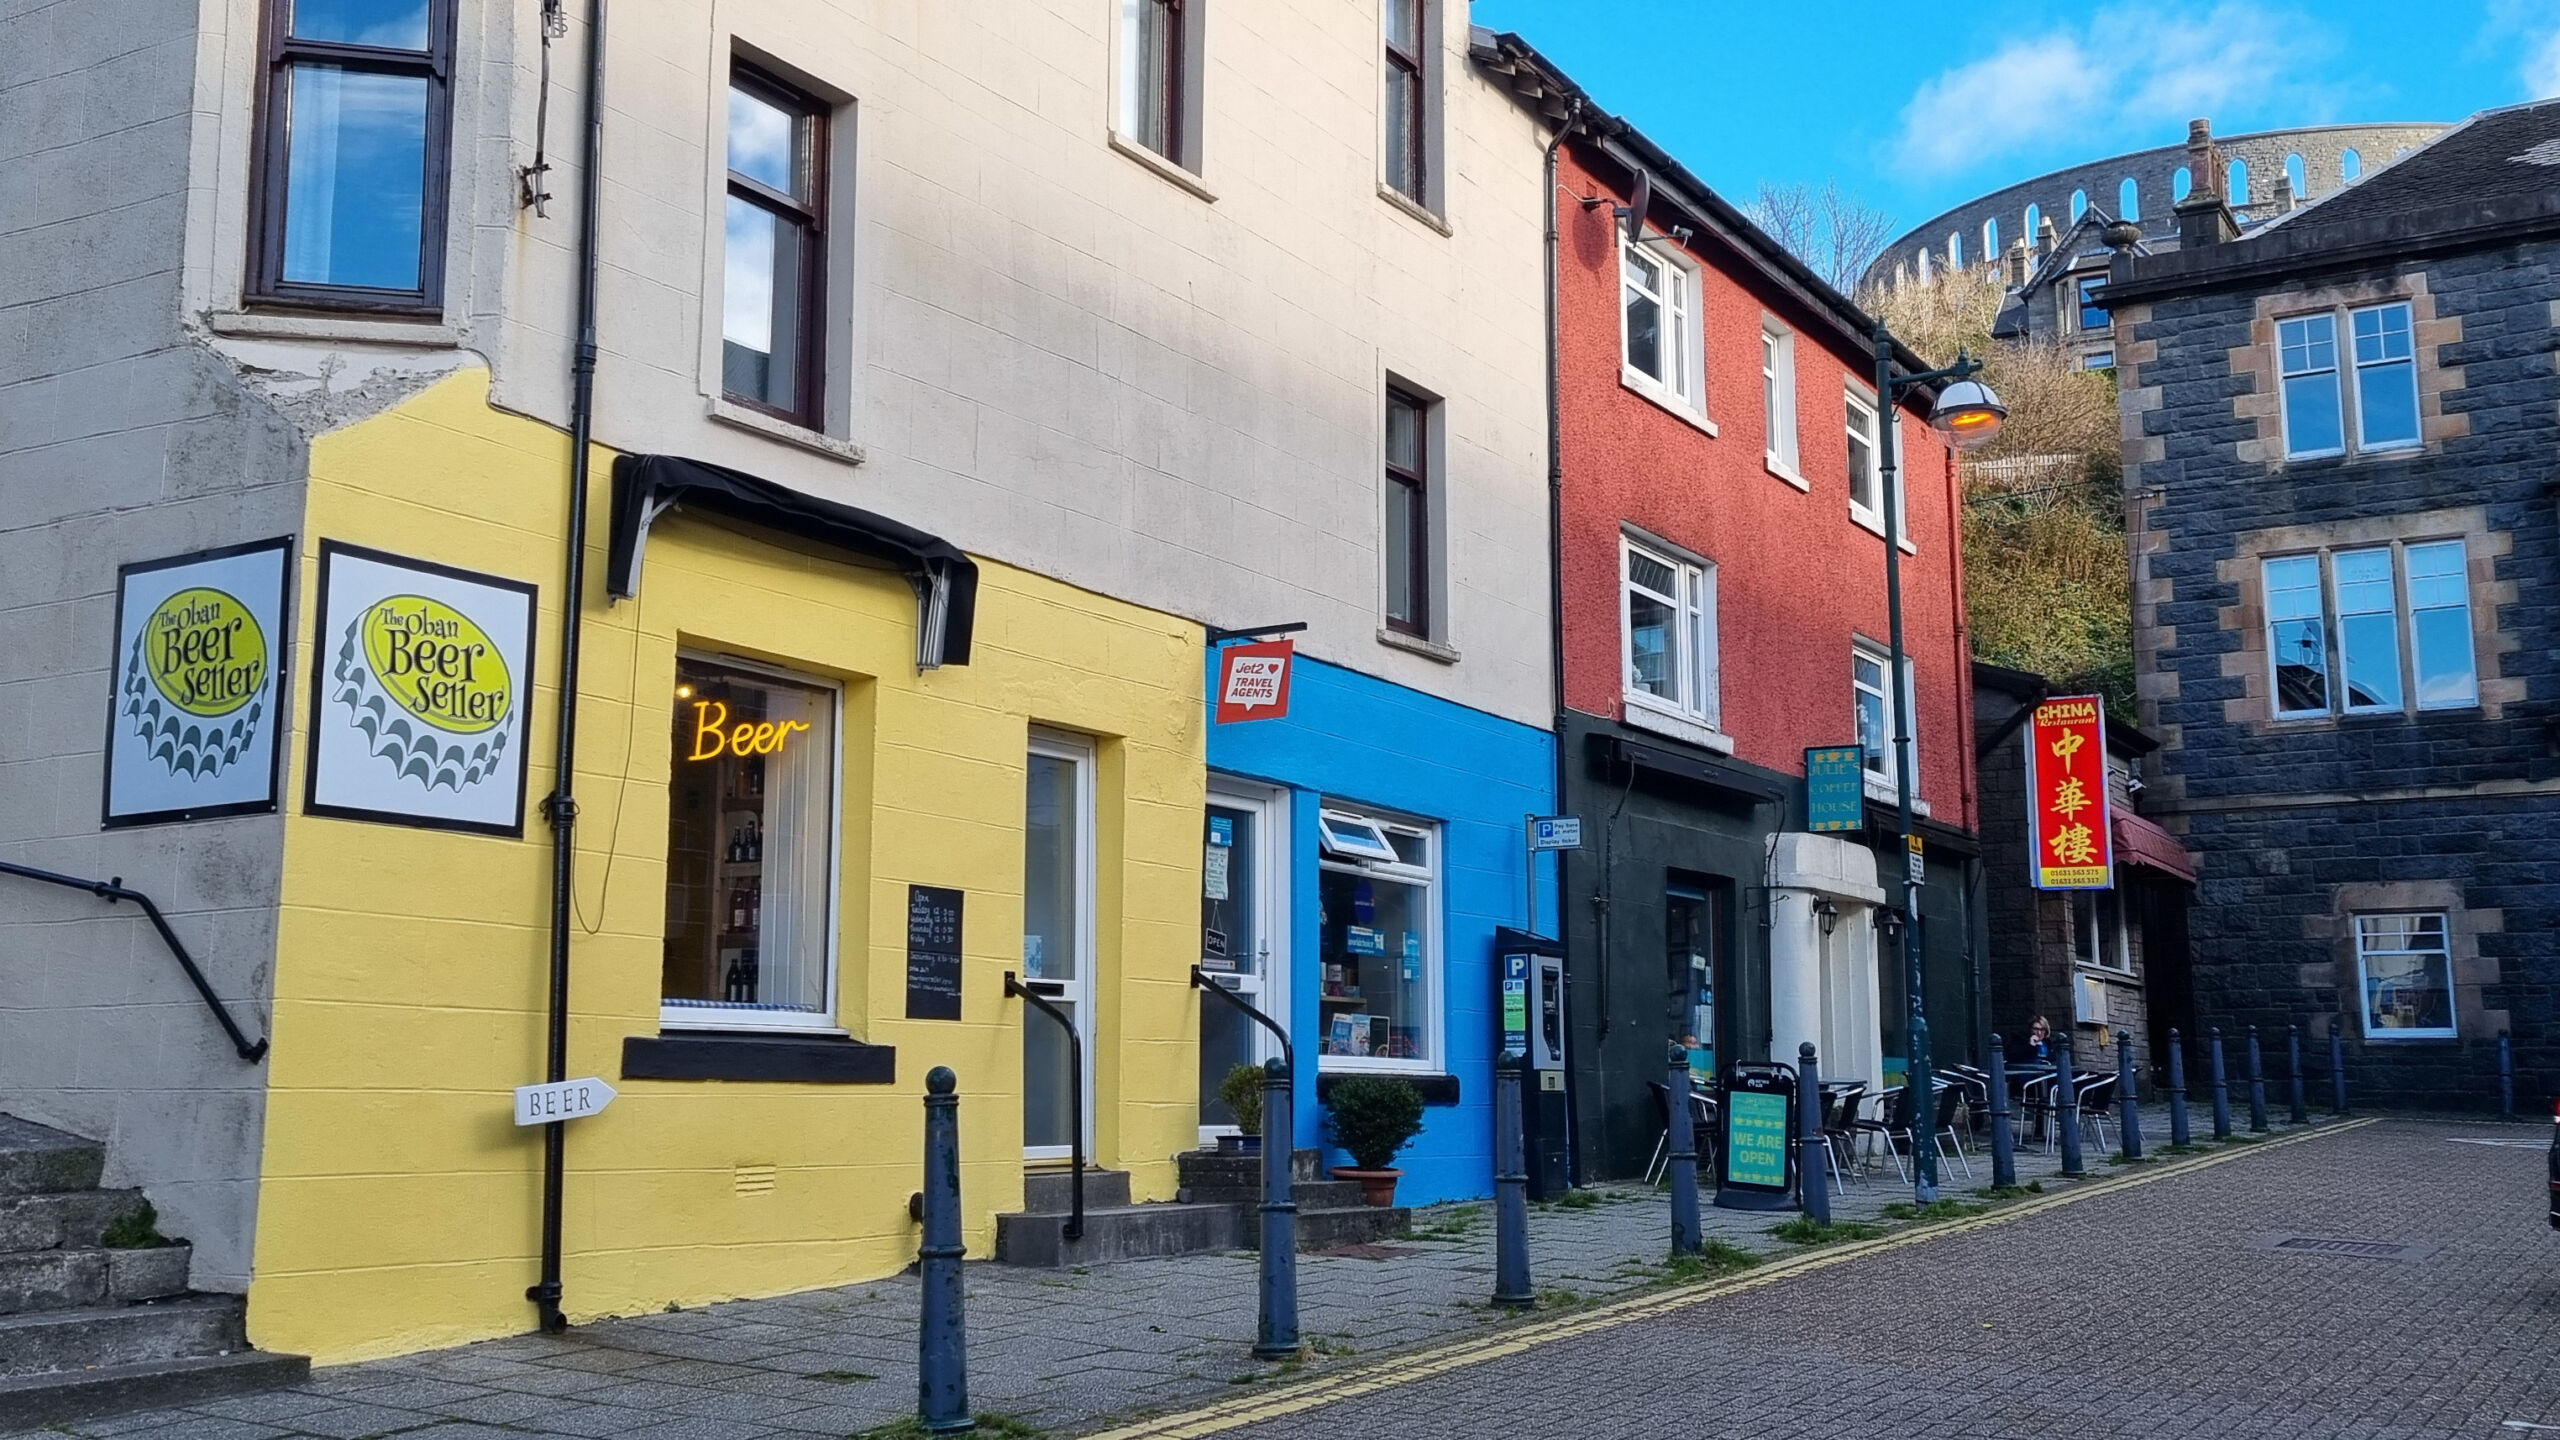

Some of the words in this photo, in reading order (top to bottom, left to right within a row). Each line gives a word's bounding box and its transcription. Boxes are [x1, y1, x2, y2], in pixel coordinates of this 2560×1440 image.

[160, 609, 177, 628] The
[177, 597, 220, 630] Oban
[380, 607, 404, 626] The
[405, 606, 459, 639] Oban
[159, 617, 242, 680] Beer
[381, 628, 485, 683] Beer
[1235, 663, 1265, 674] Jet2
[180, 660, 260, 706] Seller
[1235, 677, 1273, 688] TRAVEL
[409, 676, 504, 722] Seller
[1231, 688, 1273, 698] AGENTS
[2036, 702, 2096, 720] CHINA
[2037, 715, 2096, 727] Restaurant
[688, 701, 810, 761] Beer
[1810, 783, 1858, 794] COFFEE
[1811, 800, 1857, 813] HOUSE
[1208, 935, 1225, 948] OPEN
[530, 1086, 592, 1117] BEER
[1733, 1131, 1754, 1146] WE
[1757, 1134, 1783, 1150] ARE
[1740, 1149, 1776, 1167] OPEN
